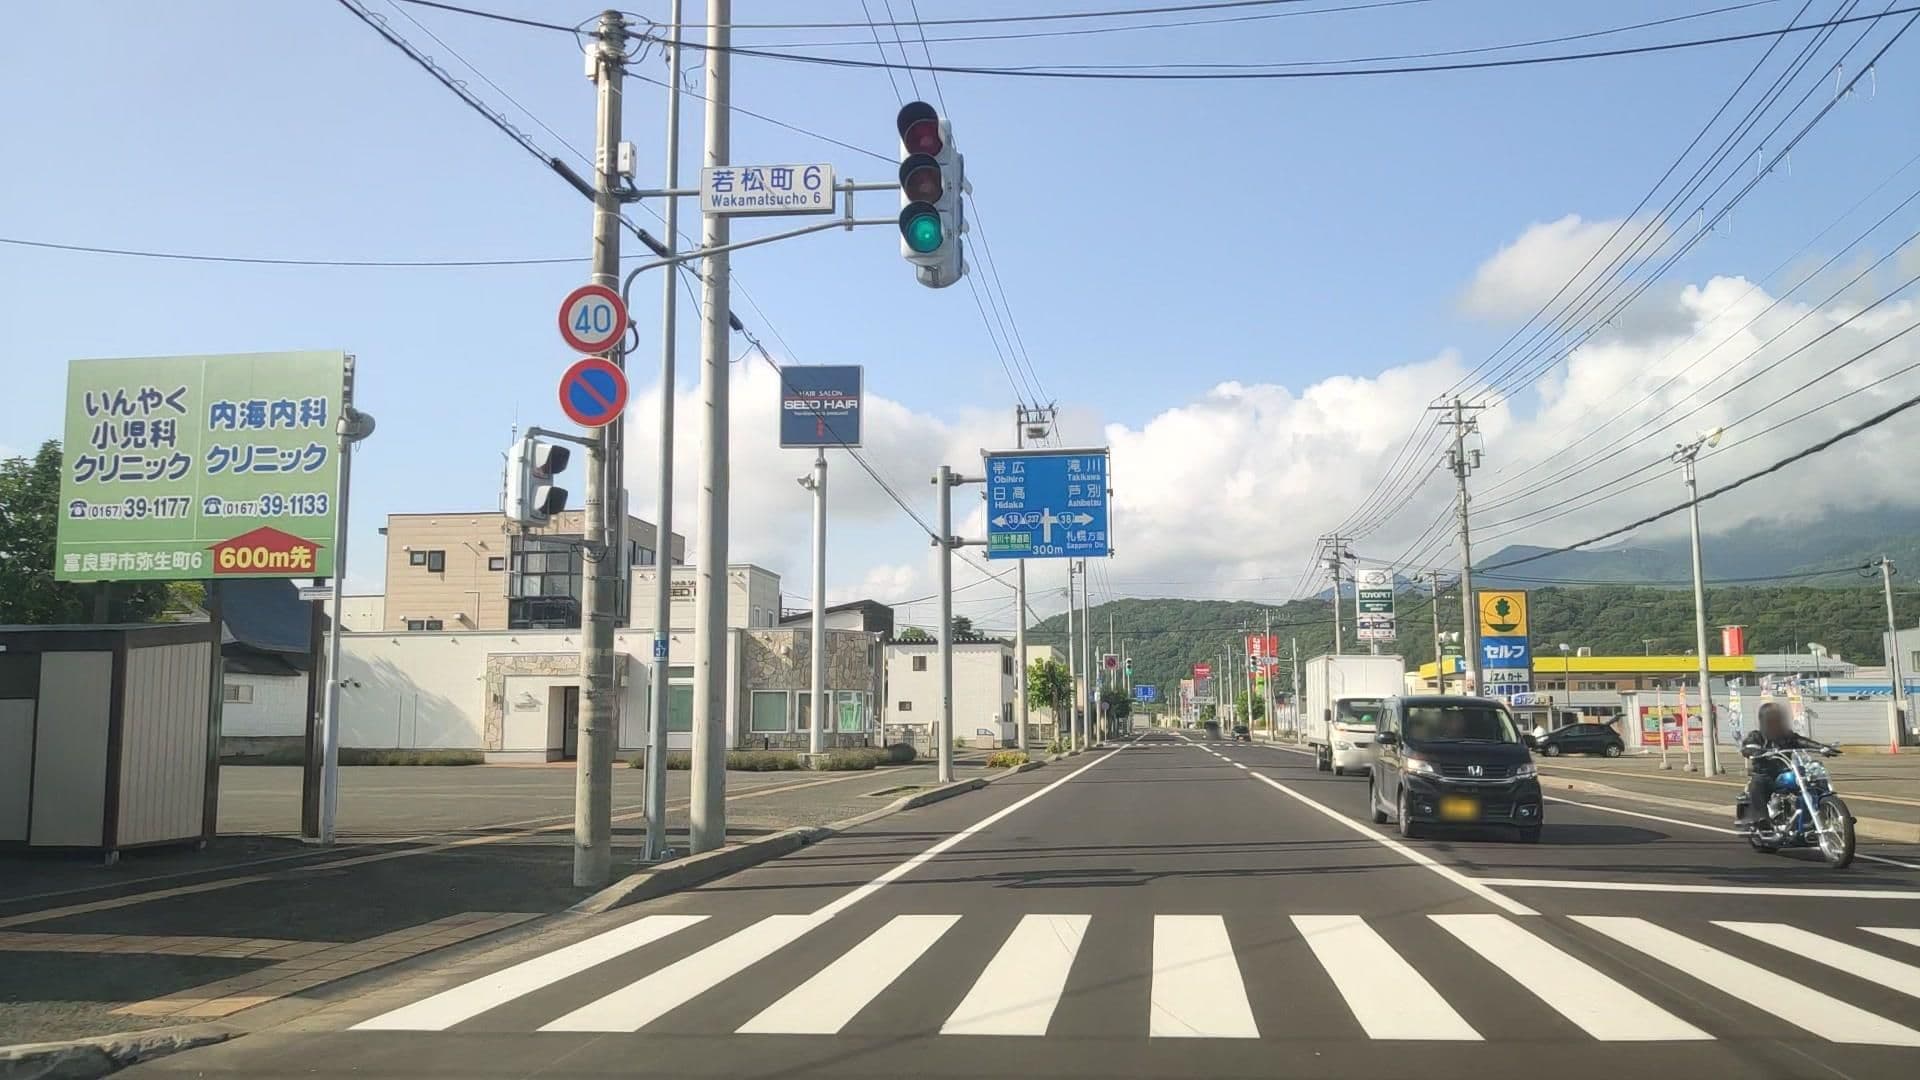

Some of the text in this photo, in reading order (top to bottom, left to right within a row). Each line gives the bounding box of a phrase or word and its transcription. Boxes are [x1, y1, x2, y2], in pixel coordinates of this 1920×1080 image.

[711, 193, 821, 207] Wakamatsucho 6
[575, 304, 612, 333] 40
[85, 386, 187, 417] いんやく
[824, 400, 858, 409] HAIR
[210, 398, 327, 429] 内海内科
[92, 419, 177, 450] 小児科
[206, 443, 327, 473] クリニック
[1067, 458, 1101, 473] 滝川
[74, 453, 191, 483] クリニック
[993, 461, 1024, 474] 帯広
[993, 475, 1024, 483] Obihiro
[994, 486, 1025, 500] 日高
[219, 545, 312, 569] 600m先
[1032, 545, 1063, 555] 300m
[63, 551, 202, 572] 富良野市弥生町6
[1484, 645, 1525, 659] セルフ
